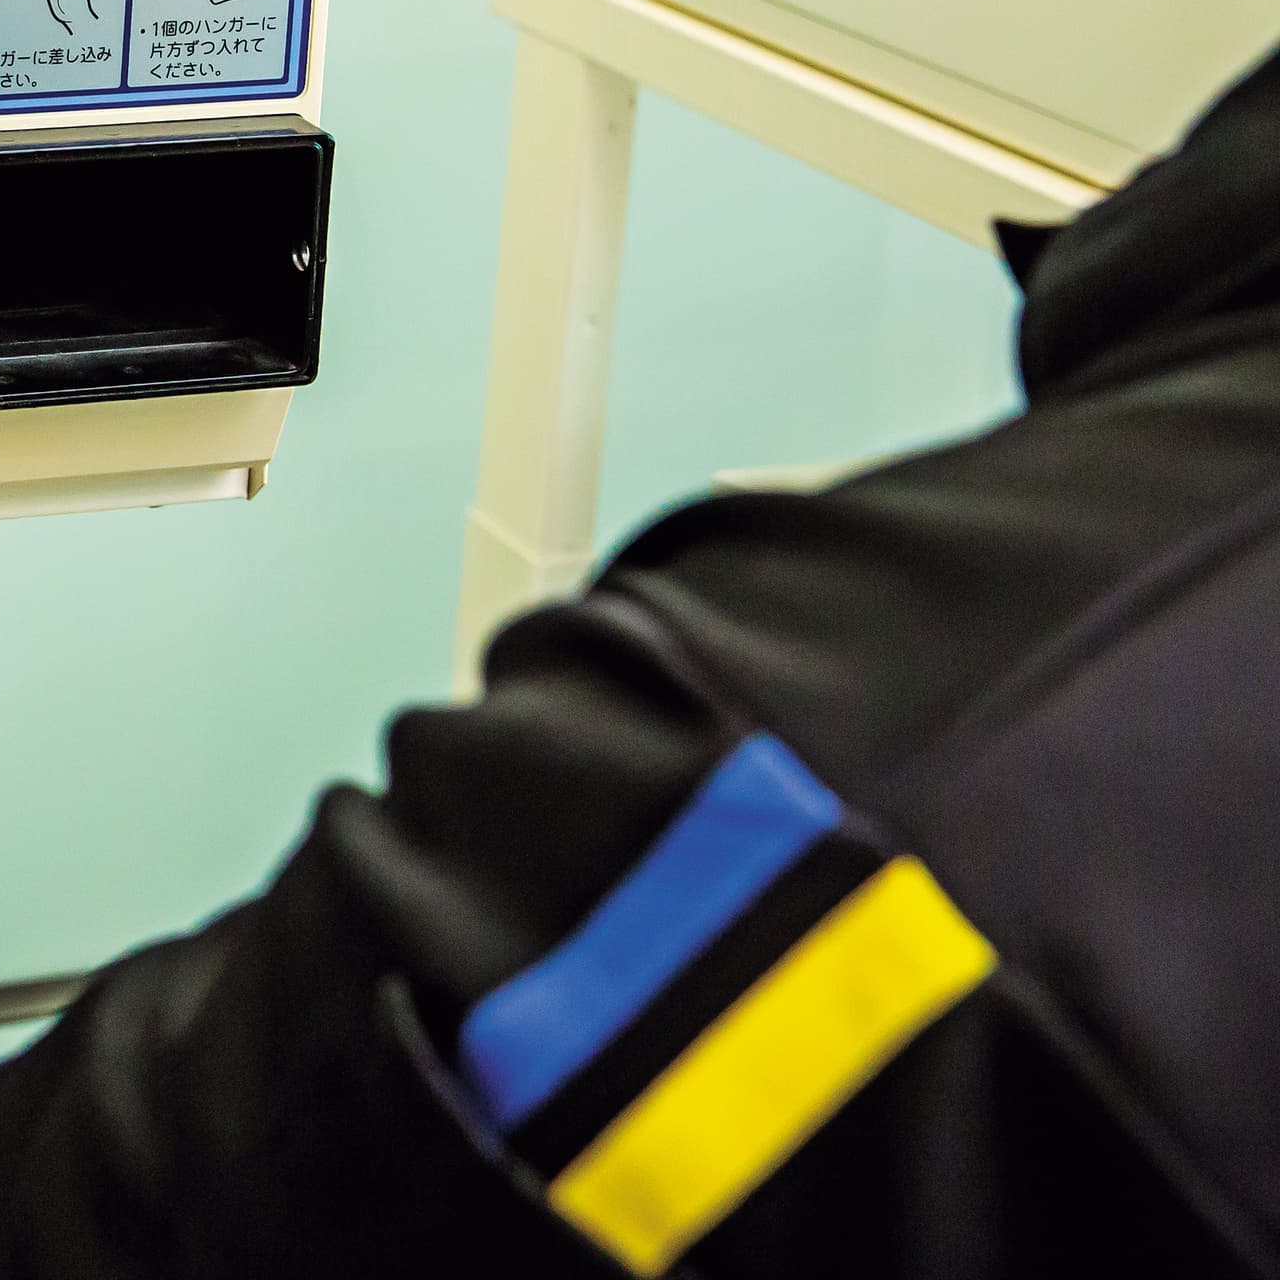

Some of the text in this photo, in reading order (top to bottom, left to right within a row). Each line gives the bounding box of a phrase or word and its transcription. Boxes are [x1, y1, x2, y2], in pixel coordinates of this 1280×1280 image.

[149, 38, 264, 60] 片方ずつ入れて
[149, 60, 223, 82] ください。
